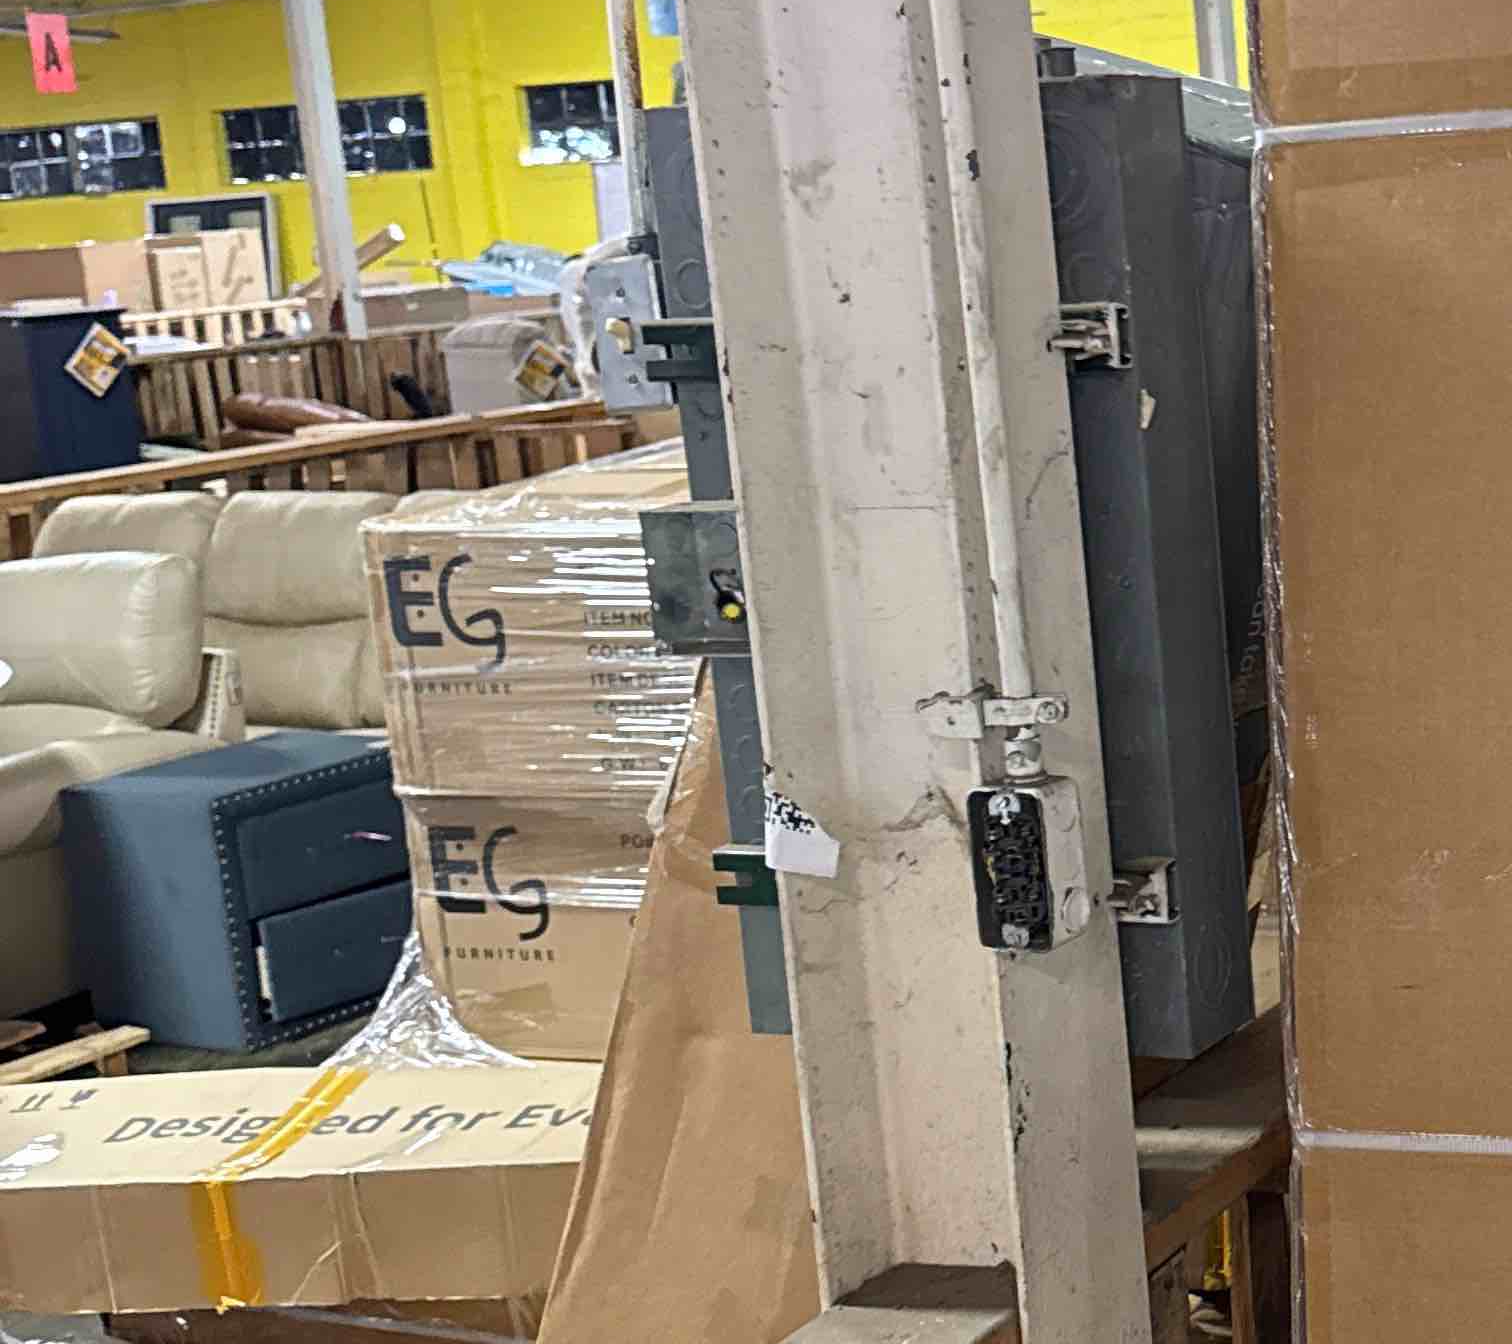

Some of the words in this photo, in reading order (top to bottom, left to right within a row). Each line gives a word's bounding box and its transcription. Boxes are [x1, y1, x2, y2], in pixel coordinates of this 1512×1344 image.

[45, 31, 62, 73] A
[383, 553, 507, 668] EG
[428, 825, 550, 942] EG
[443, 946, 556, 962] FURNITURE
[103, 1105, 398, 1146] Desiged
[401, 1104, 503, 1134] for
